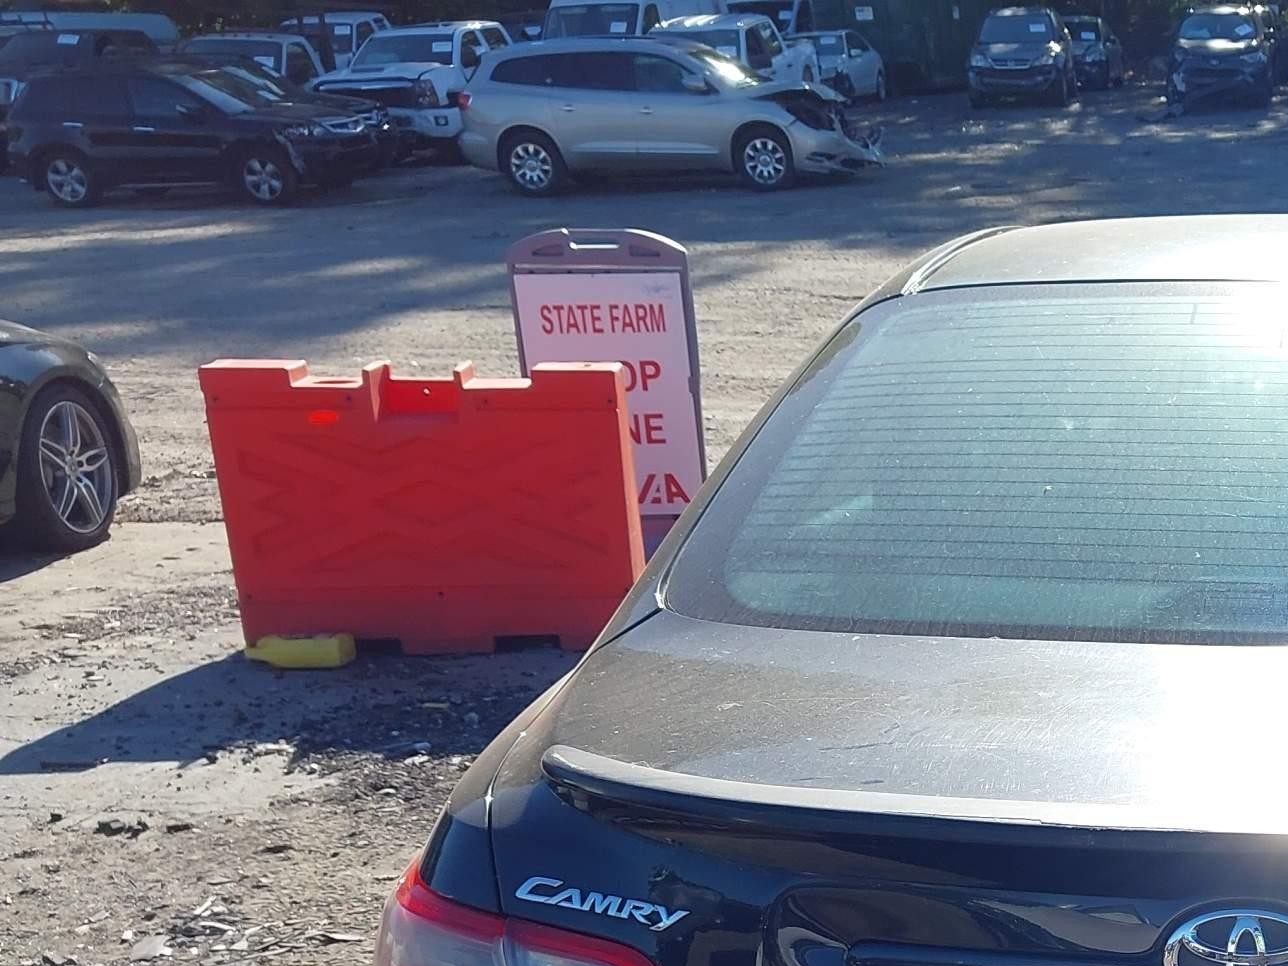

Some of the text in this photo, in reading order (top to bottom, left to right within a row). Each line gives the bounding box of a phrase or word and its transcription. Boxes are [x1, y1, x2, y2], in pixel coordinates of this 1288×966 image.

[540, 303, 667, 335] STATE FARM
[515, 876, 691, 931] CAMRY
